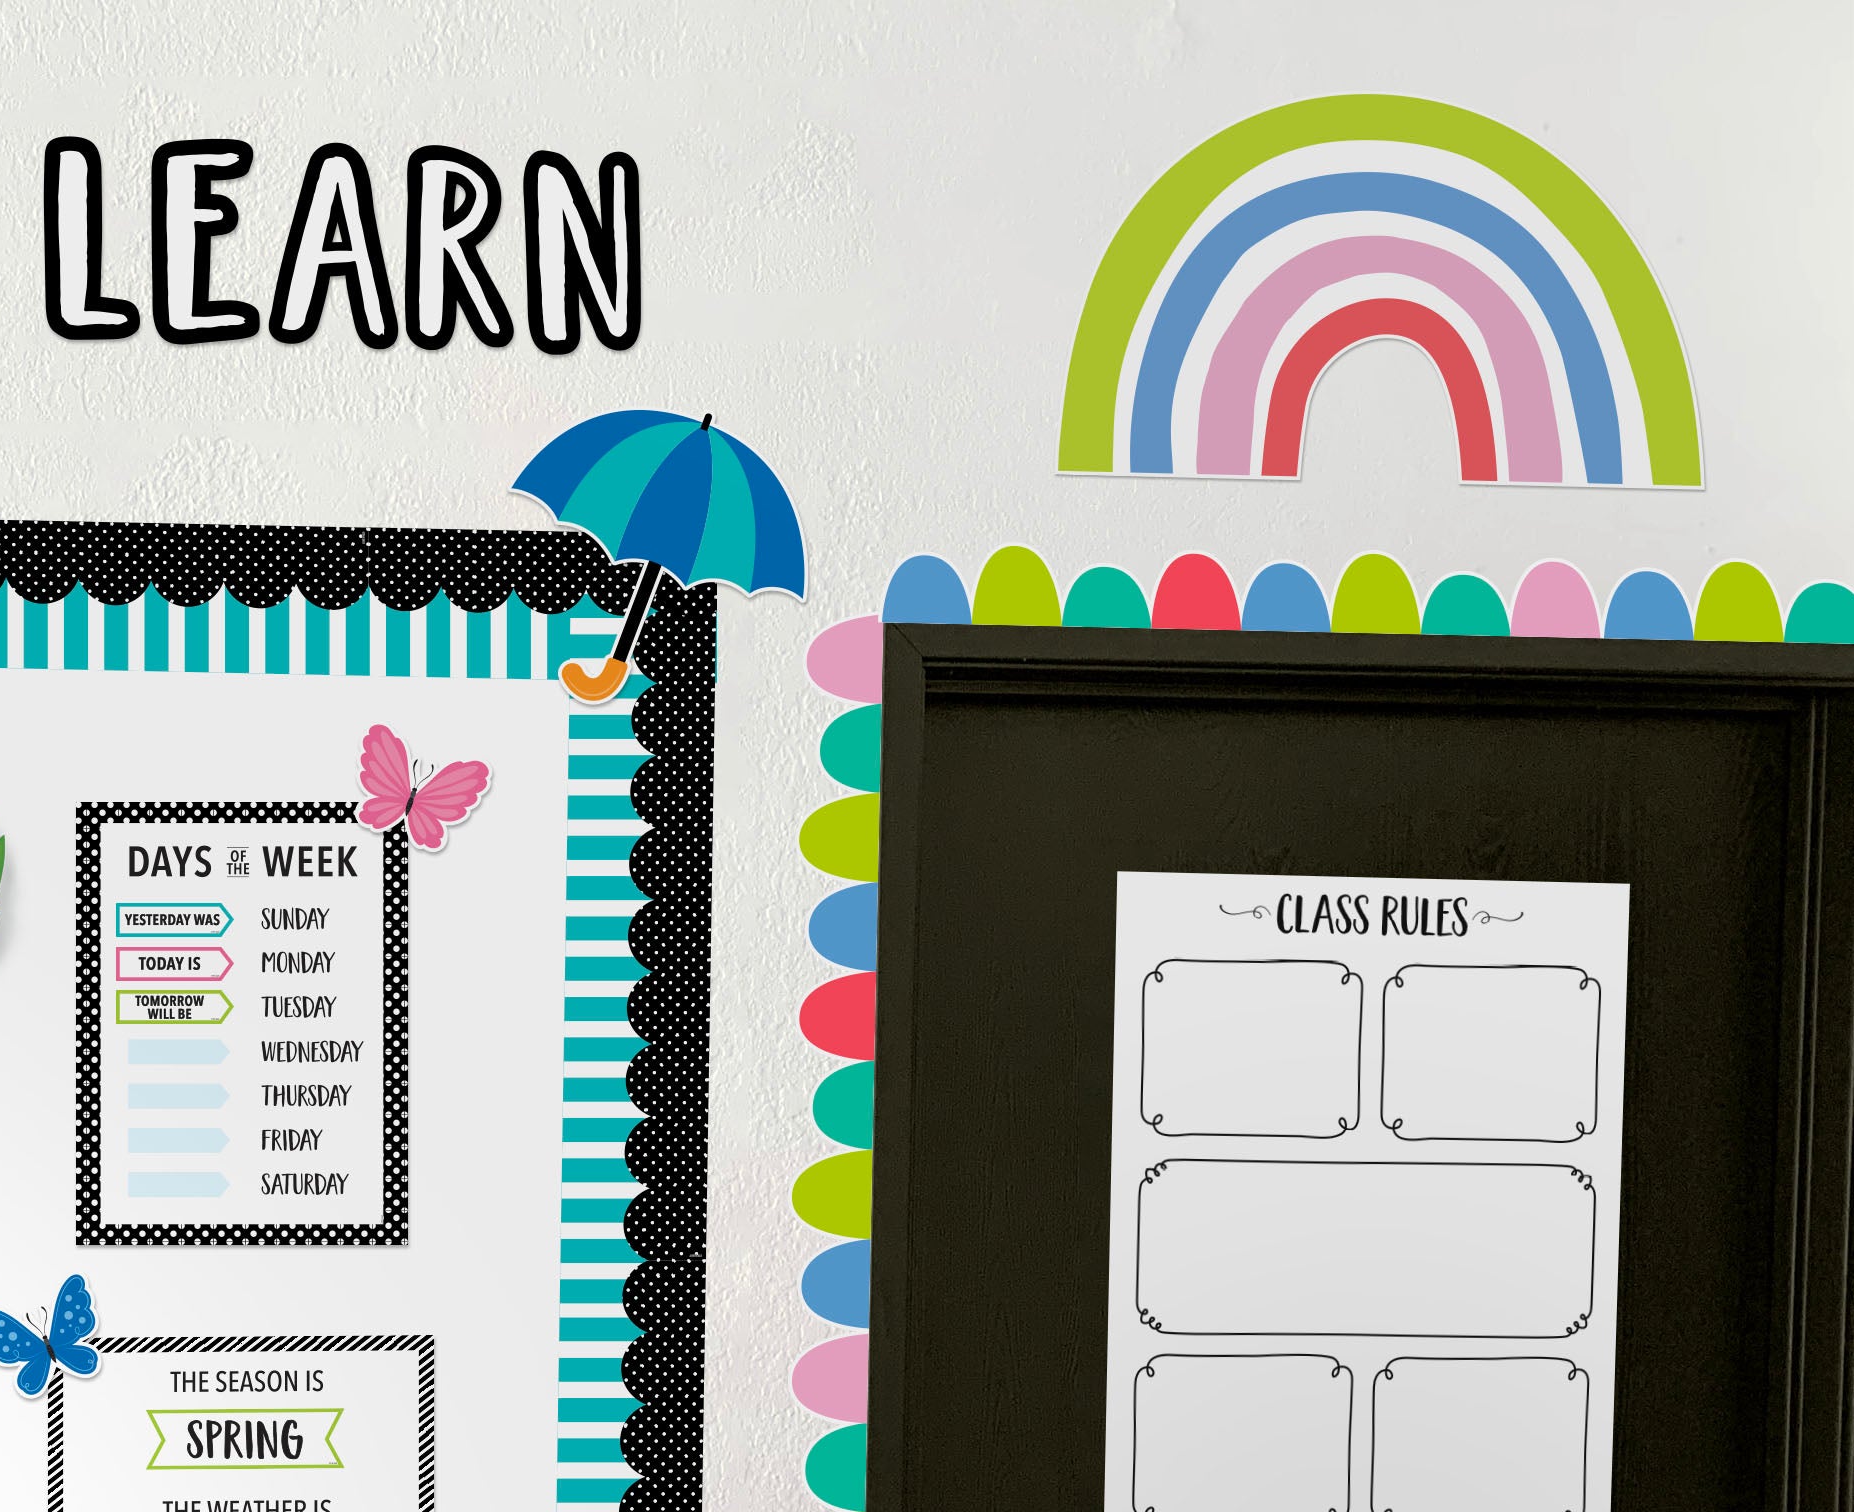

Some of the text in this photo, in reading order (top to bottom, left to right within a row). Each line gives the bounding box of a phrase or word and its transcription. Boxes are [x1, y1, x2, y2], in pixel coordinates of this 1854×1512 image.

[44, 135, 641, 355] LEARN
[129, 845, 357, 877] DAYS OF THE WEEK
[125, 914, 220, 926] YESTERDAY WAS
[261, 907, 329, 930] SUNDAY
[1277, 894, 1468, 937] CLASS RULES
[139, 957, 200, 970] TODAY IS
[262, 952, 335, 974] MONDAY
[135, 995, 204, 1006] TOMORROW
[261, 996, 336, 1018] TUESDAY
[148, 1008, 191, 1019] WILL BE
[262, 1041, 363, 1063] WEDNESDAY
[262, 1085, 352, 1107] THURSDAY
[262, 1129, 322, 1151] FRIDAY
[262, 1173, 349, 1195] SATURDAY
[170, 1370, 323, 1392] THE SEASON IS
[187, 1420, 303, 1459] SPRING
